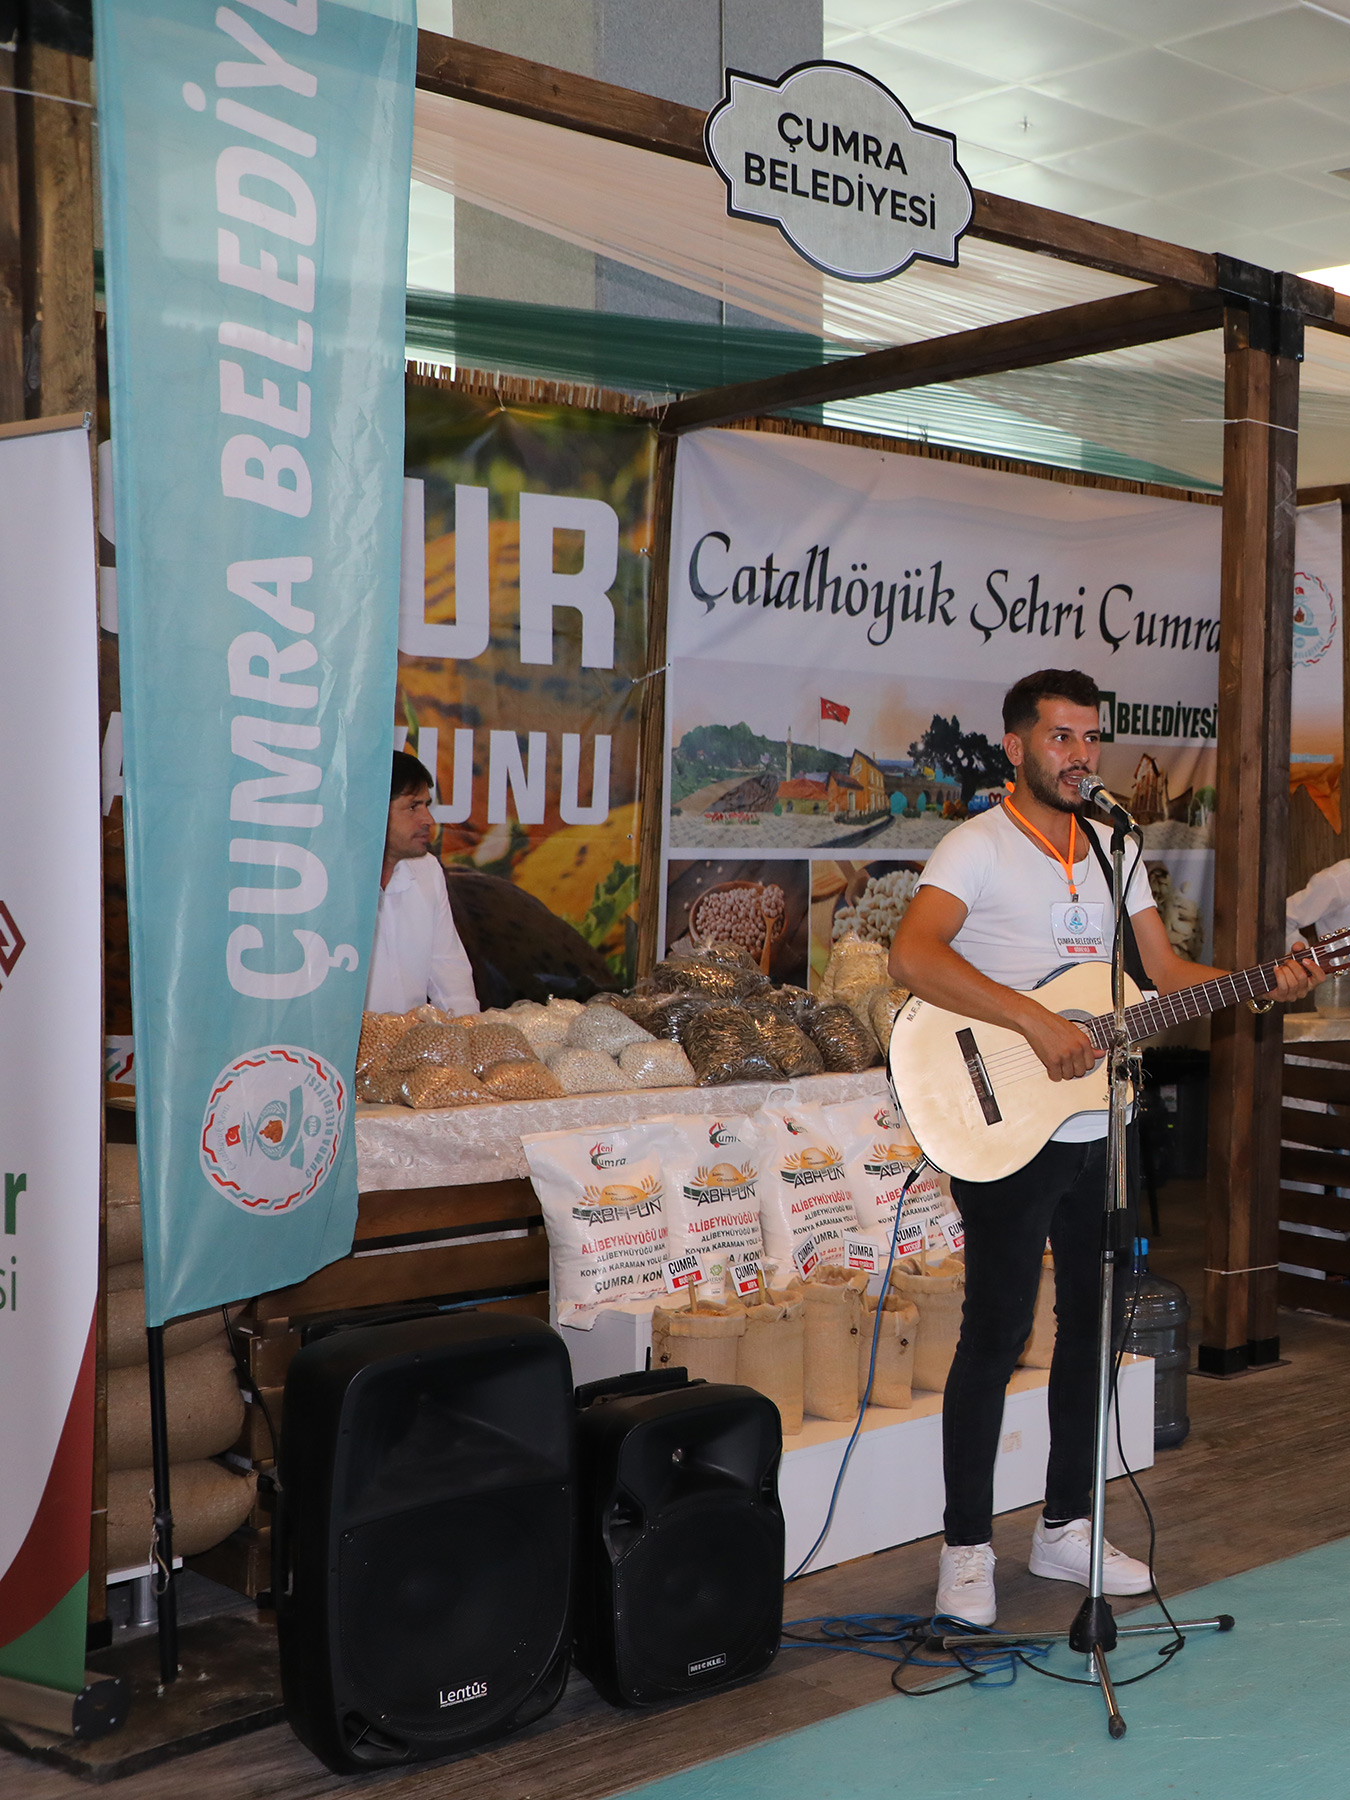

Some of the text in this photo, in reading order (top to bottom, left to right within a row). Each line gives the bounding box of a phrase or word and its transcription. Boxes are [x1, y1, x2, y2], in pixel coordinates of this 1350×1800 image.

[777, 111, 908, 176] ÇUMRA
[744, 151, 936, 230] BELEDİYESİ
[182, 0, 360, 1001] ÇUMRA BELEDİY
[688, 530, 956, 647] Çatalhöyük
[970, 569, 1087, 646] Şehri
[1117, 700, 1218, 738] BELEDİYESİ
[791, 1189, 846, 1215] ALİBEYHÜYÜĞÜ
[688, 1211, 753, 1234] ALİBEYHÜYÜĞÜ
[896, 1224, 923, 1244] ÇUMRA
[581, 1228, 657, 1255] ALİBEYHÜYÜĞÜ
[813, 1229, 840, 1245] UMRA
[798, 1240, 815, 1264] ÇUMRA
[848, 1243, 874, 1258] ÇUMRA
[668, 1255, 699, 1277] ÇUMRA
[735, 1262, 760, 1281] ÇUMRA
[595, 1274, 634, 1296] ÇUMRA
